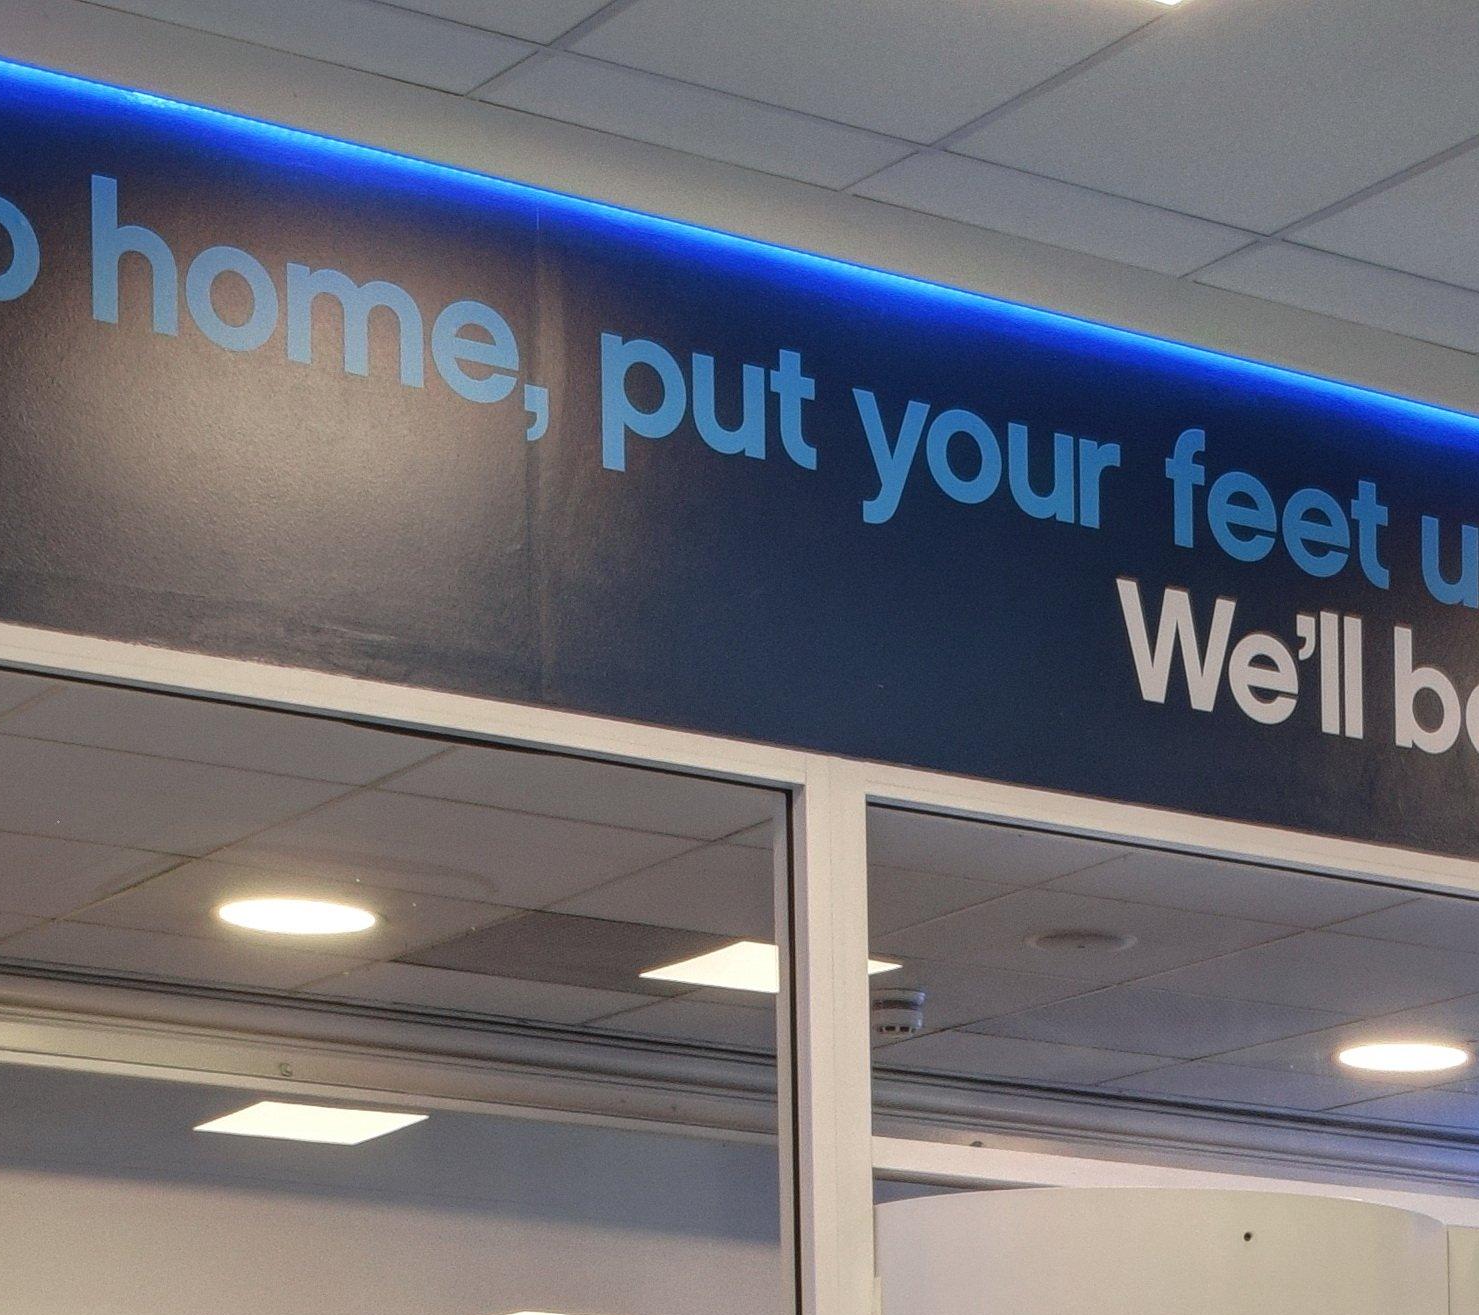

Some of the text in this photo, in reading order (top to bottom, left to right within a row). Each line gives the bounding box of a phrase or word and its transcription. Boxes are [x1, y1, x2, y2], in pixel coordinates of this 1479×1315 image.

[89, 173, 550, 442] home,
[600, 331, 818, 472] put
[851, 386, 1120, 531] your
[1165, 428, 1390, 591] feet
[1116, 576, 1363, 741] We'll
